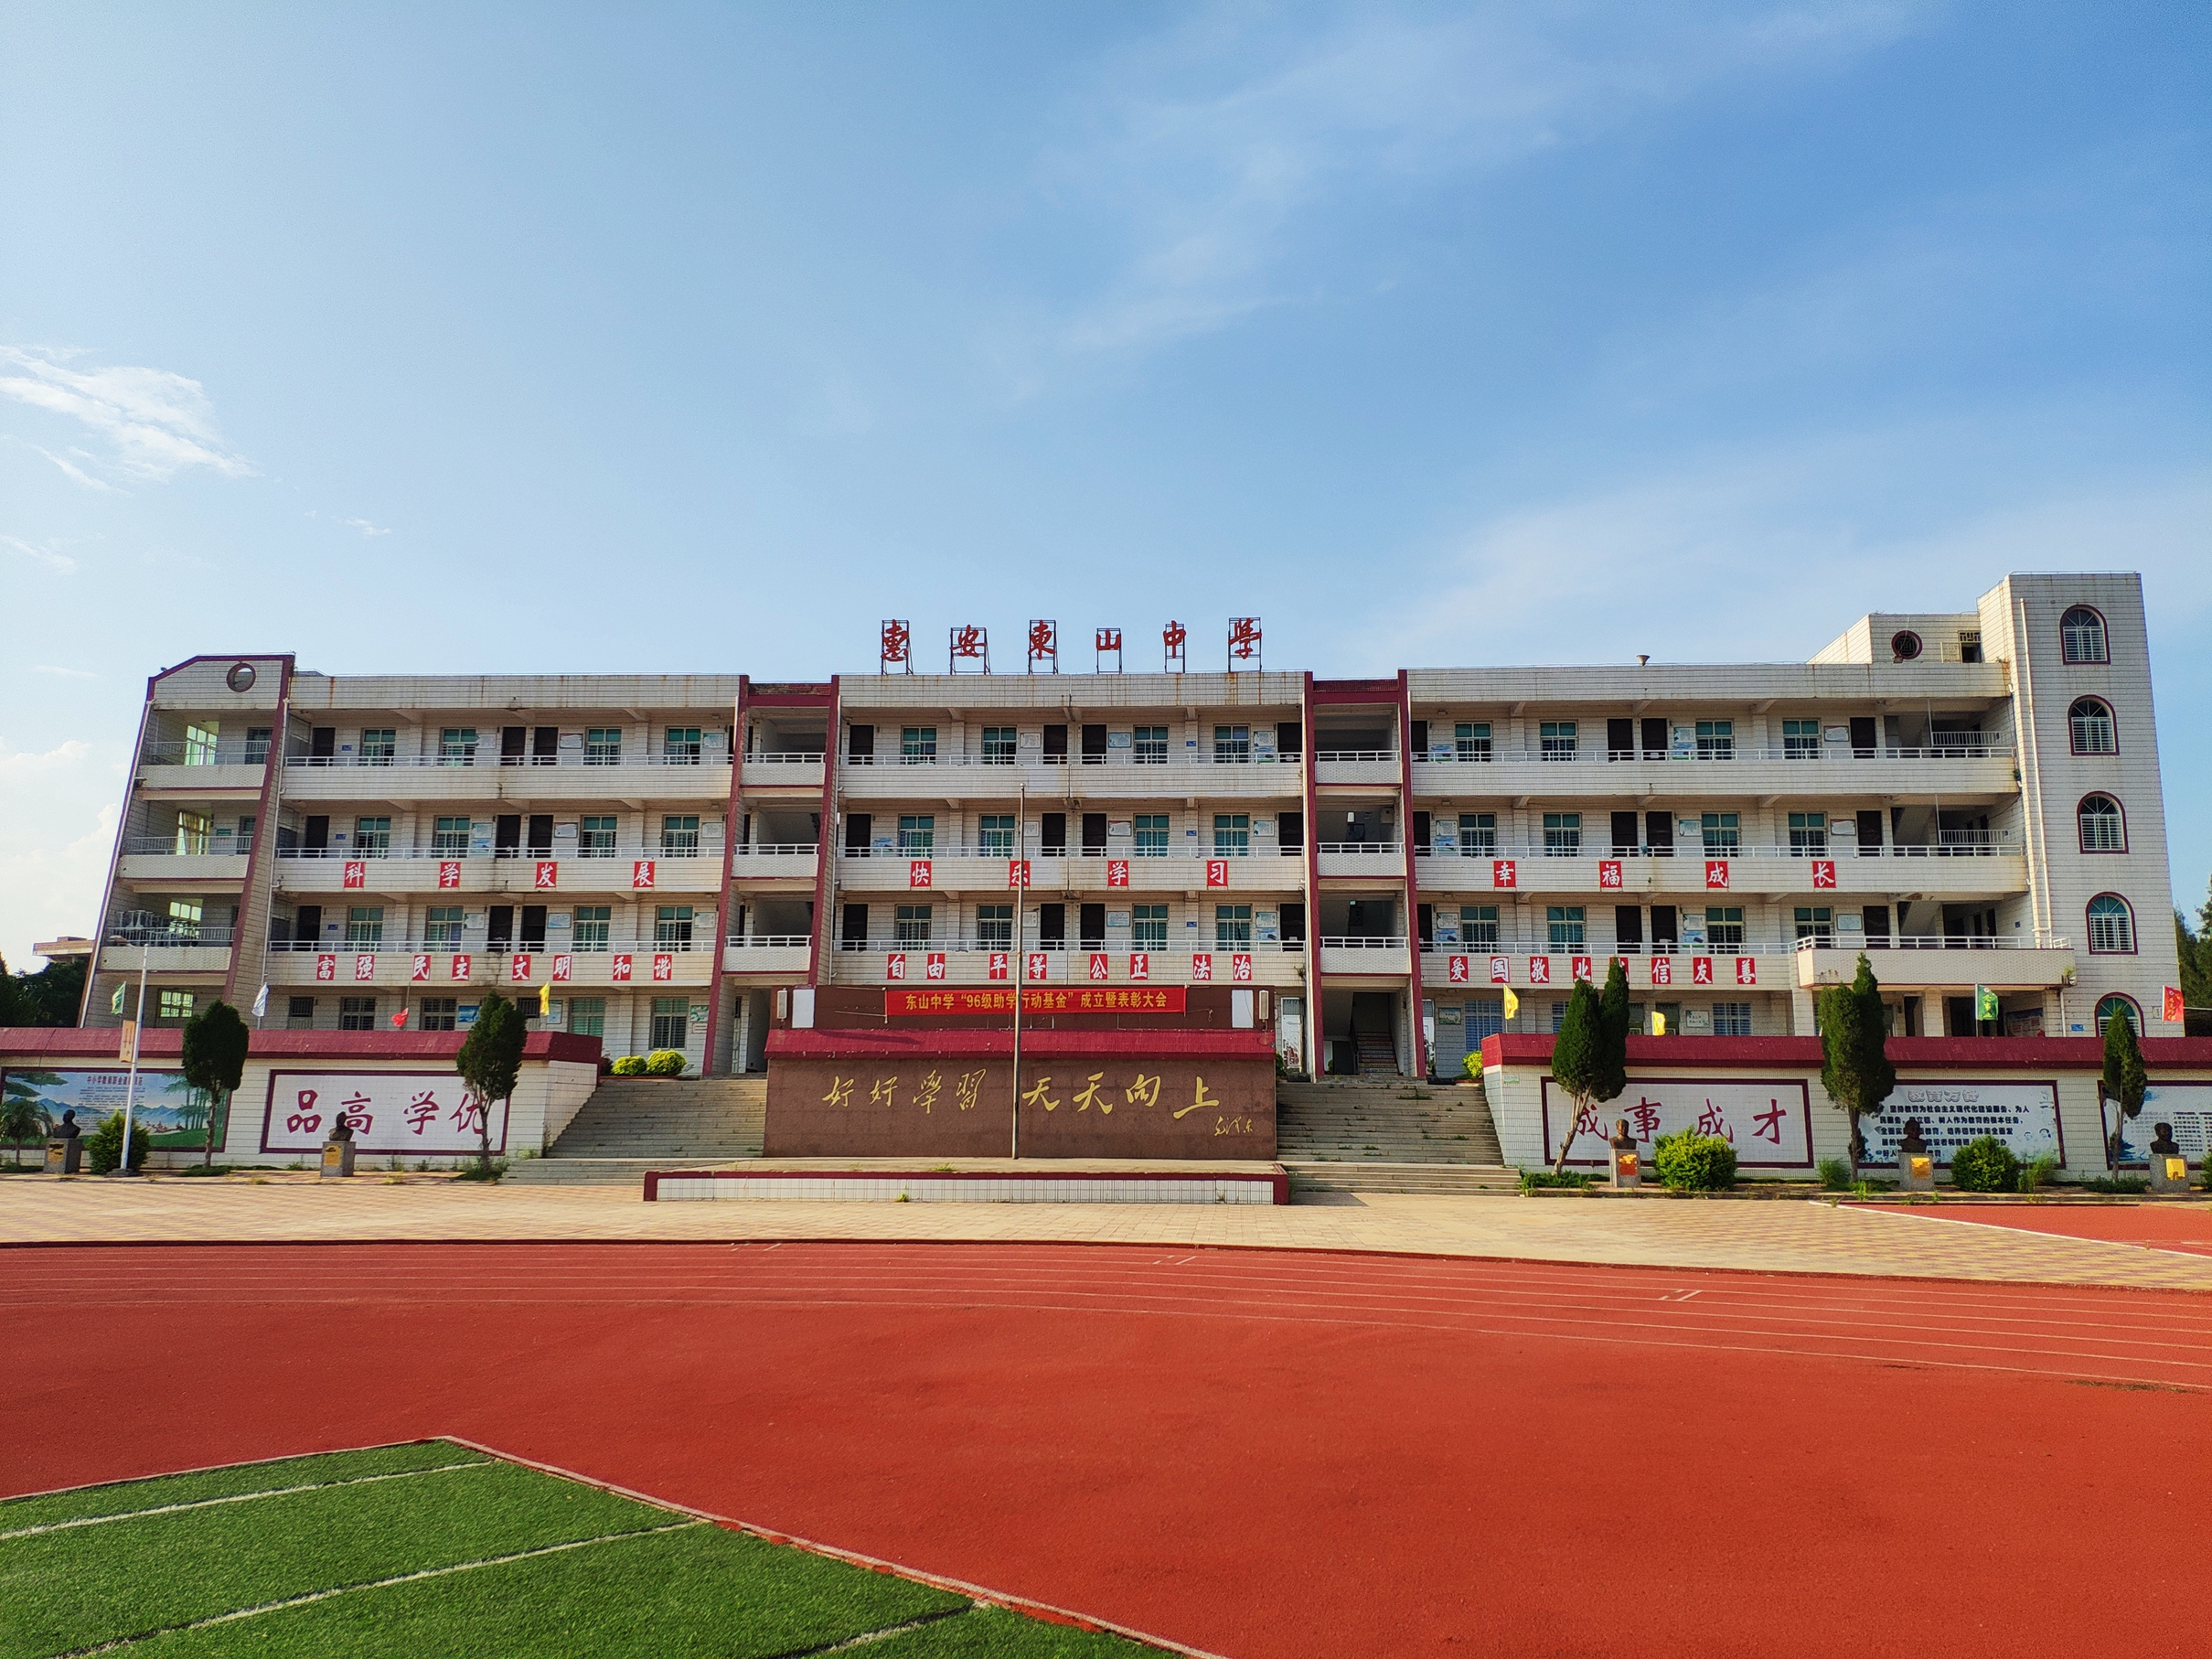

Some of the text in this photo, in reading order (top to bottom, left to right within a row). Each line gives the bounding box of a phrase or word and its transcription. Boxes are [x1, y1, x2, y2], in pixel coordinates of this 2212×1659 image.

[346, 862, 654, 887] 科学发展
[913, 862, 1227, 886] 快乐学习
[1496, 862, 1834, 887] 幸福成长
[318, 956, 671, 980] 富强民主文明和谐
[888, 955, 1250, 979] 自由平等公正法治
[1450, 958, 1755, 983] 爱国敬业信友善
[286, 1089, 486, 1135] 品高学优
[1576, 1097, 1787, 1144] 成事成才
